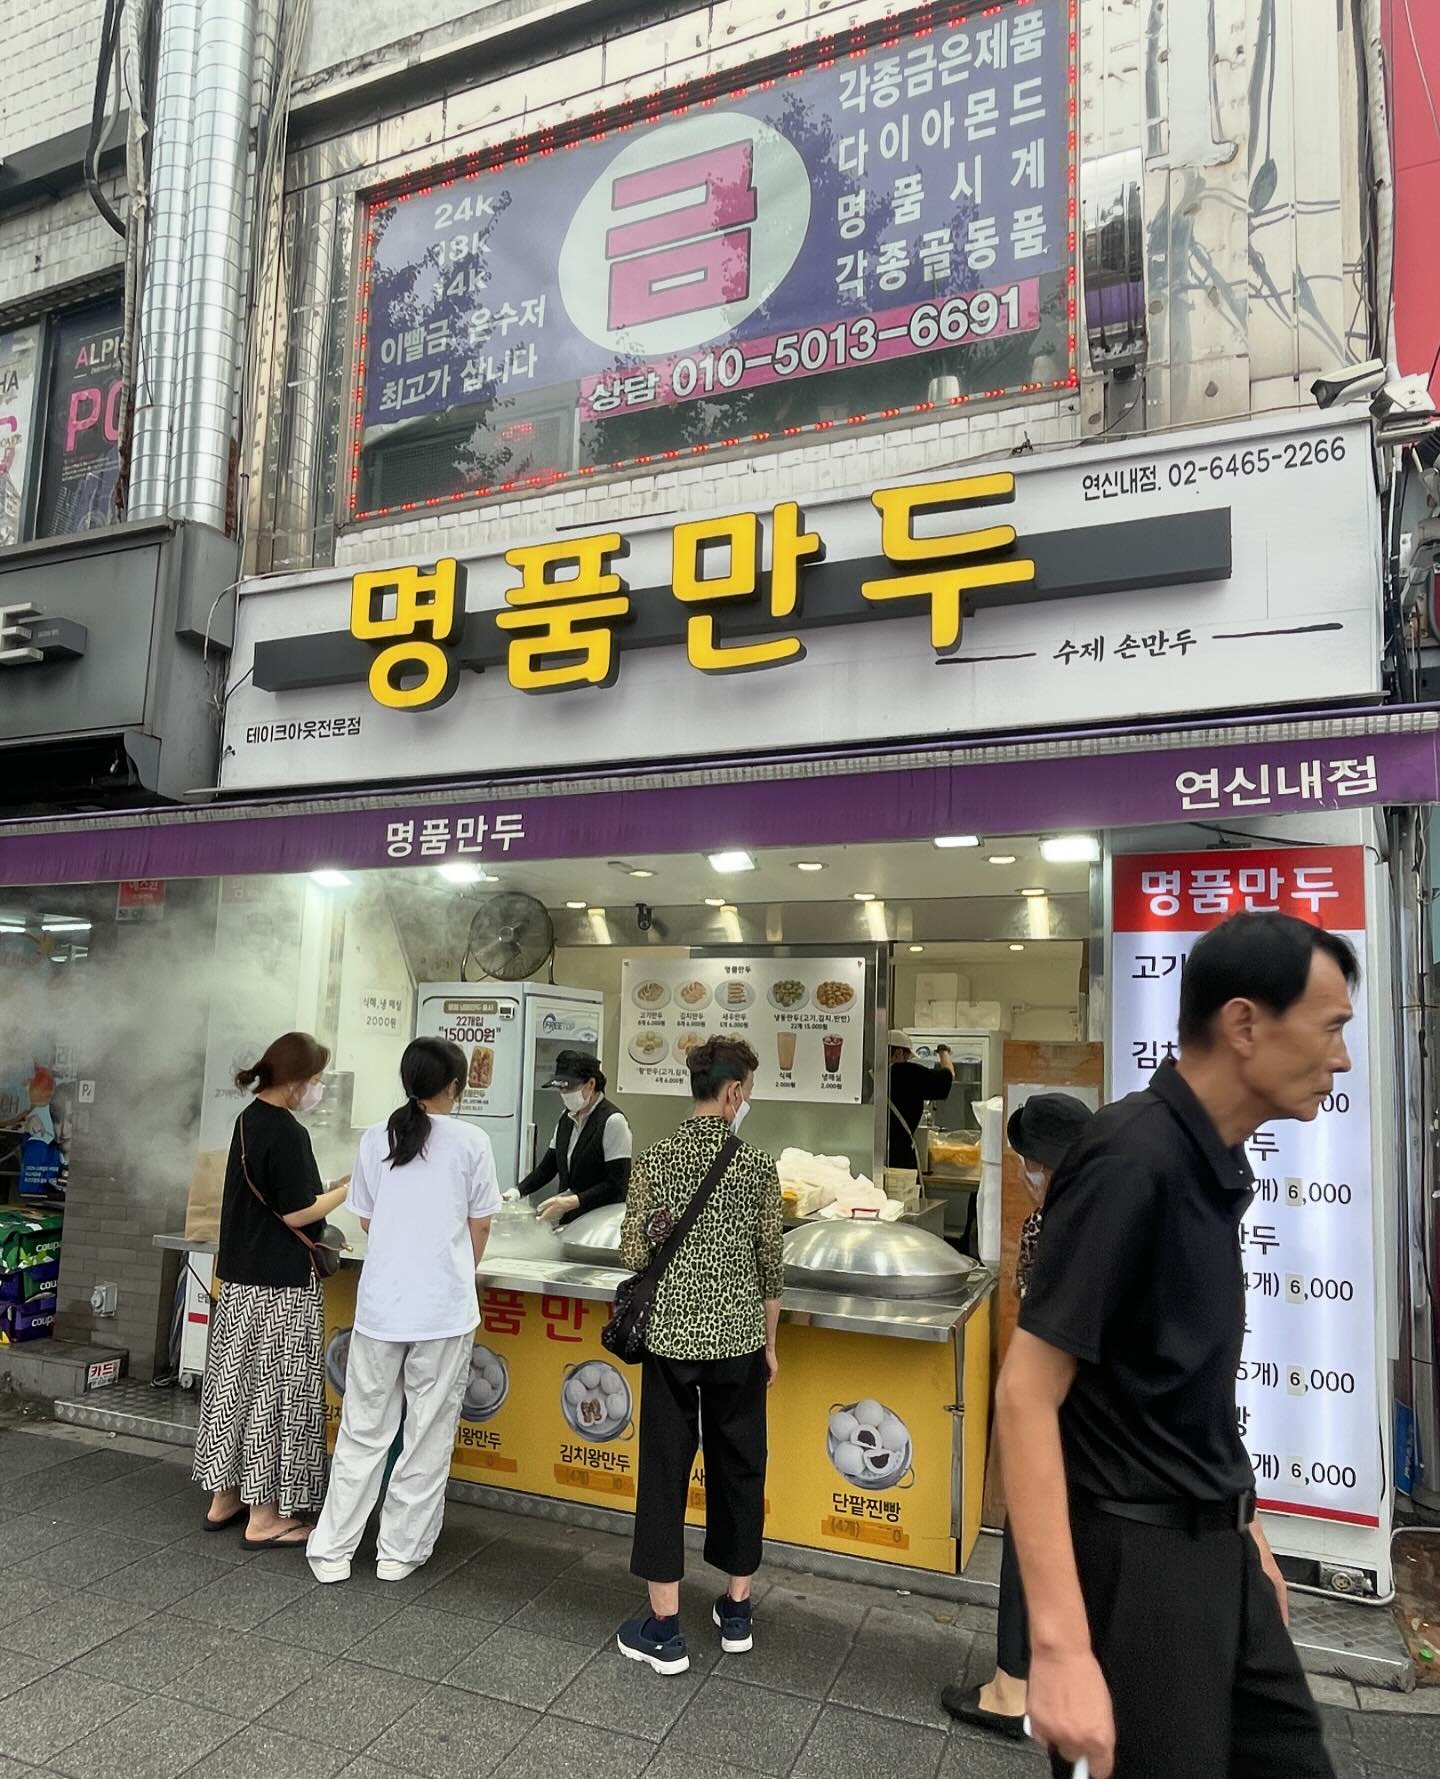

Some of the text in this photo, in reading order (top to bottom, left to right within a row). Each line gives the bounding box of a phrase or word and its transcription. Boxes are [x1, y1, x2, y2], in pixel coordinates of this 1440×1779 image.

[838, 9, 1046, 113] 각종금은제품
[838, 77, 1046, 176] 다이아몬드
[606, 138, 758, 331] 금
[835, 205, 1047, 297] 각종골동품
[380, 294, 546, 366] 이빨금 은수저
[588, 286, 1021, 412] 상담 010-5013-6691
[379, 364, 451, 411] 최고가
[1169, 436, 1346, 487] 02-6465-2266
[350, 471, 1036, 710] 명품만두
[1053, 629, 1197, 665] 수제 손만두
[246, 716, 362, 745] 테이크아웃전문점
[1175, 755, 1379, 811] 연신내점
[386, 813, 526, 858] 명품만두
[1141, 867, 1340, 917] 명품만두
[1288, 1182, 1352, 1205] 6,000
[1290, 1277, 1354, 1301] 6,000
[1290, 1369, 1355, 1394] 6,000
[560, 1444, 631, 1473] 김치왕만두
[1291, 1462, 1357, 1489] 6,000
[832, 1492, 901, 1523] 단팥찐빵
